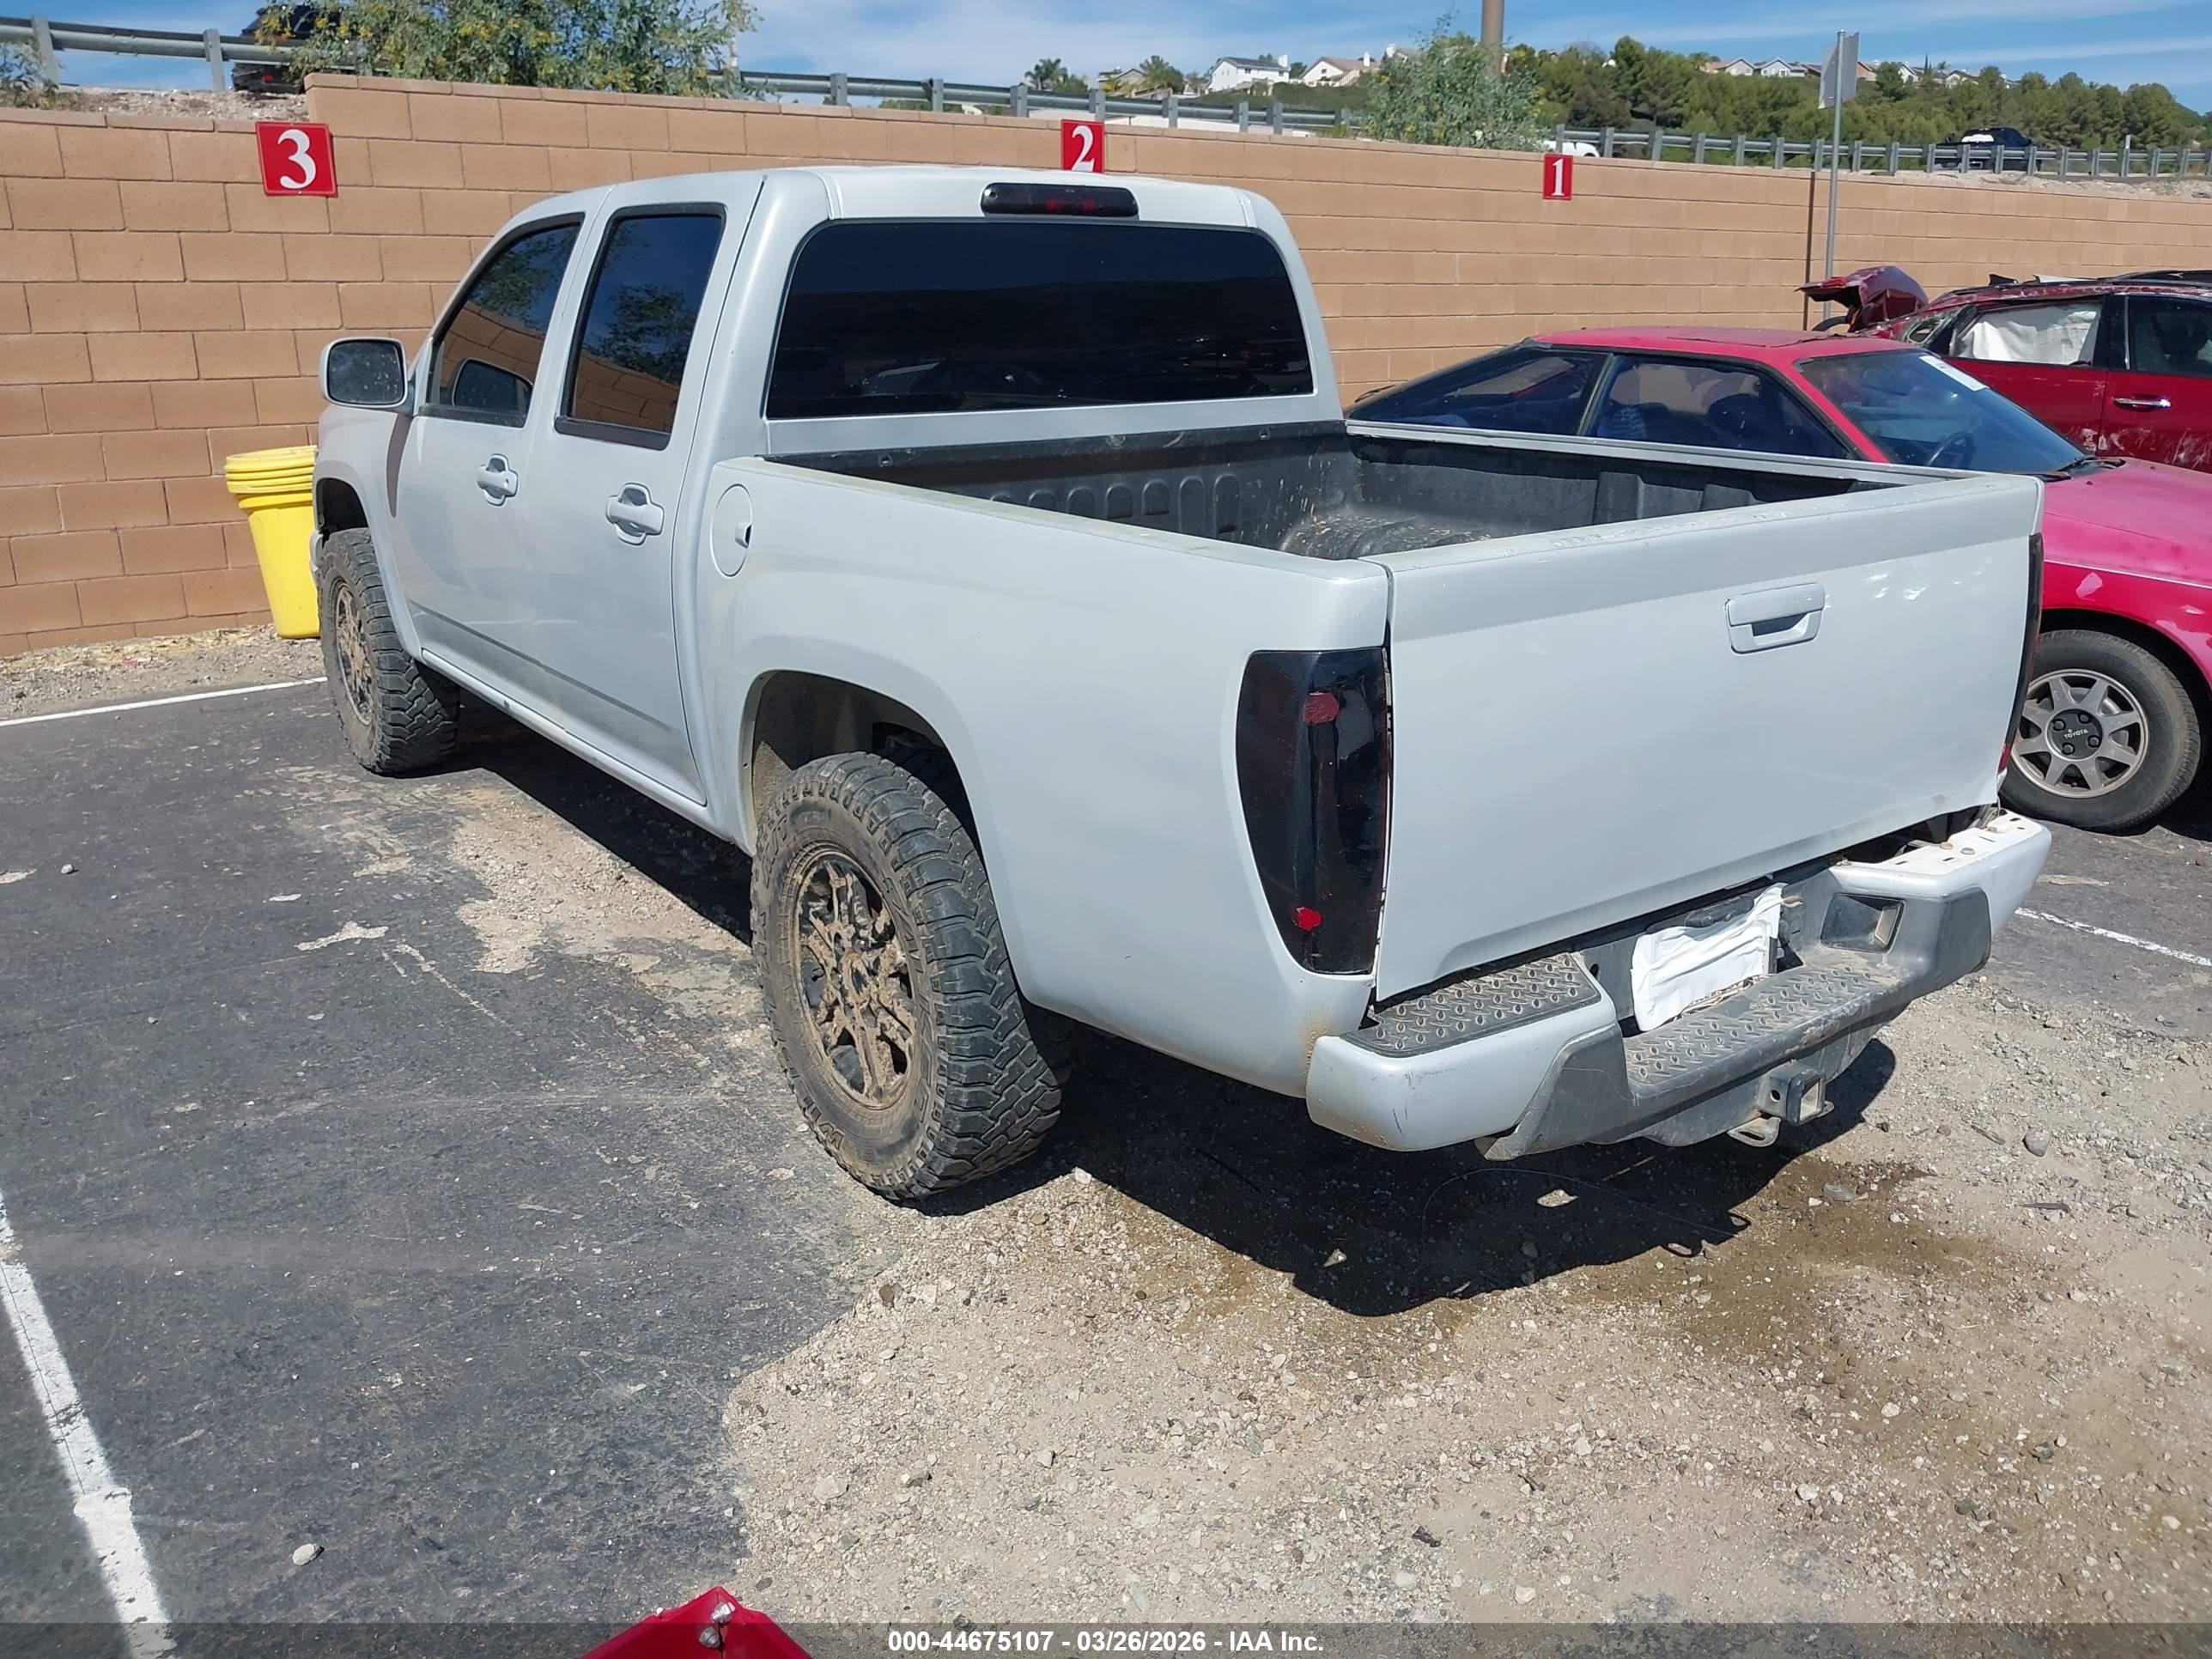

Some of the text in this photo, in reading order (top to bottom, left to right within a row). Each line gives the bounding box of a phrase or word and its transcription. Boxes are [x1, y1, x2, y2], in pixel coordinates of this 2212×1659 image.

[276, 129, 318, 190] 3
[1072, 125, 1096, 173] 2
[1551, 157, 1565, 197] 1
[2063, 729, 2088, 739] TOYOTA
